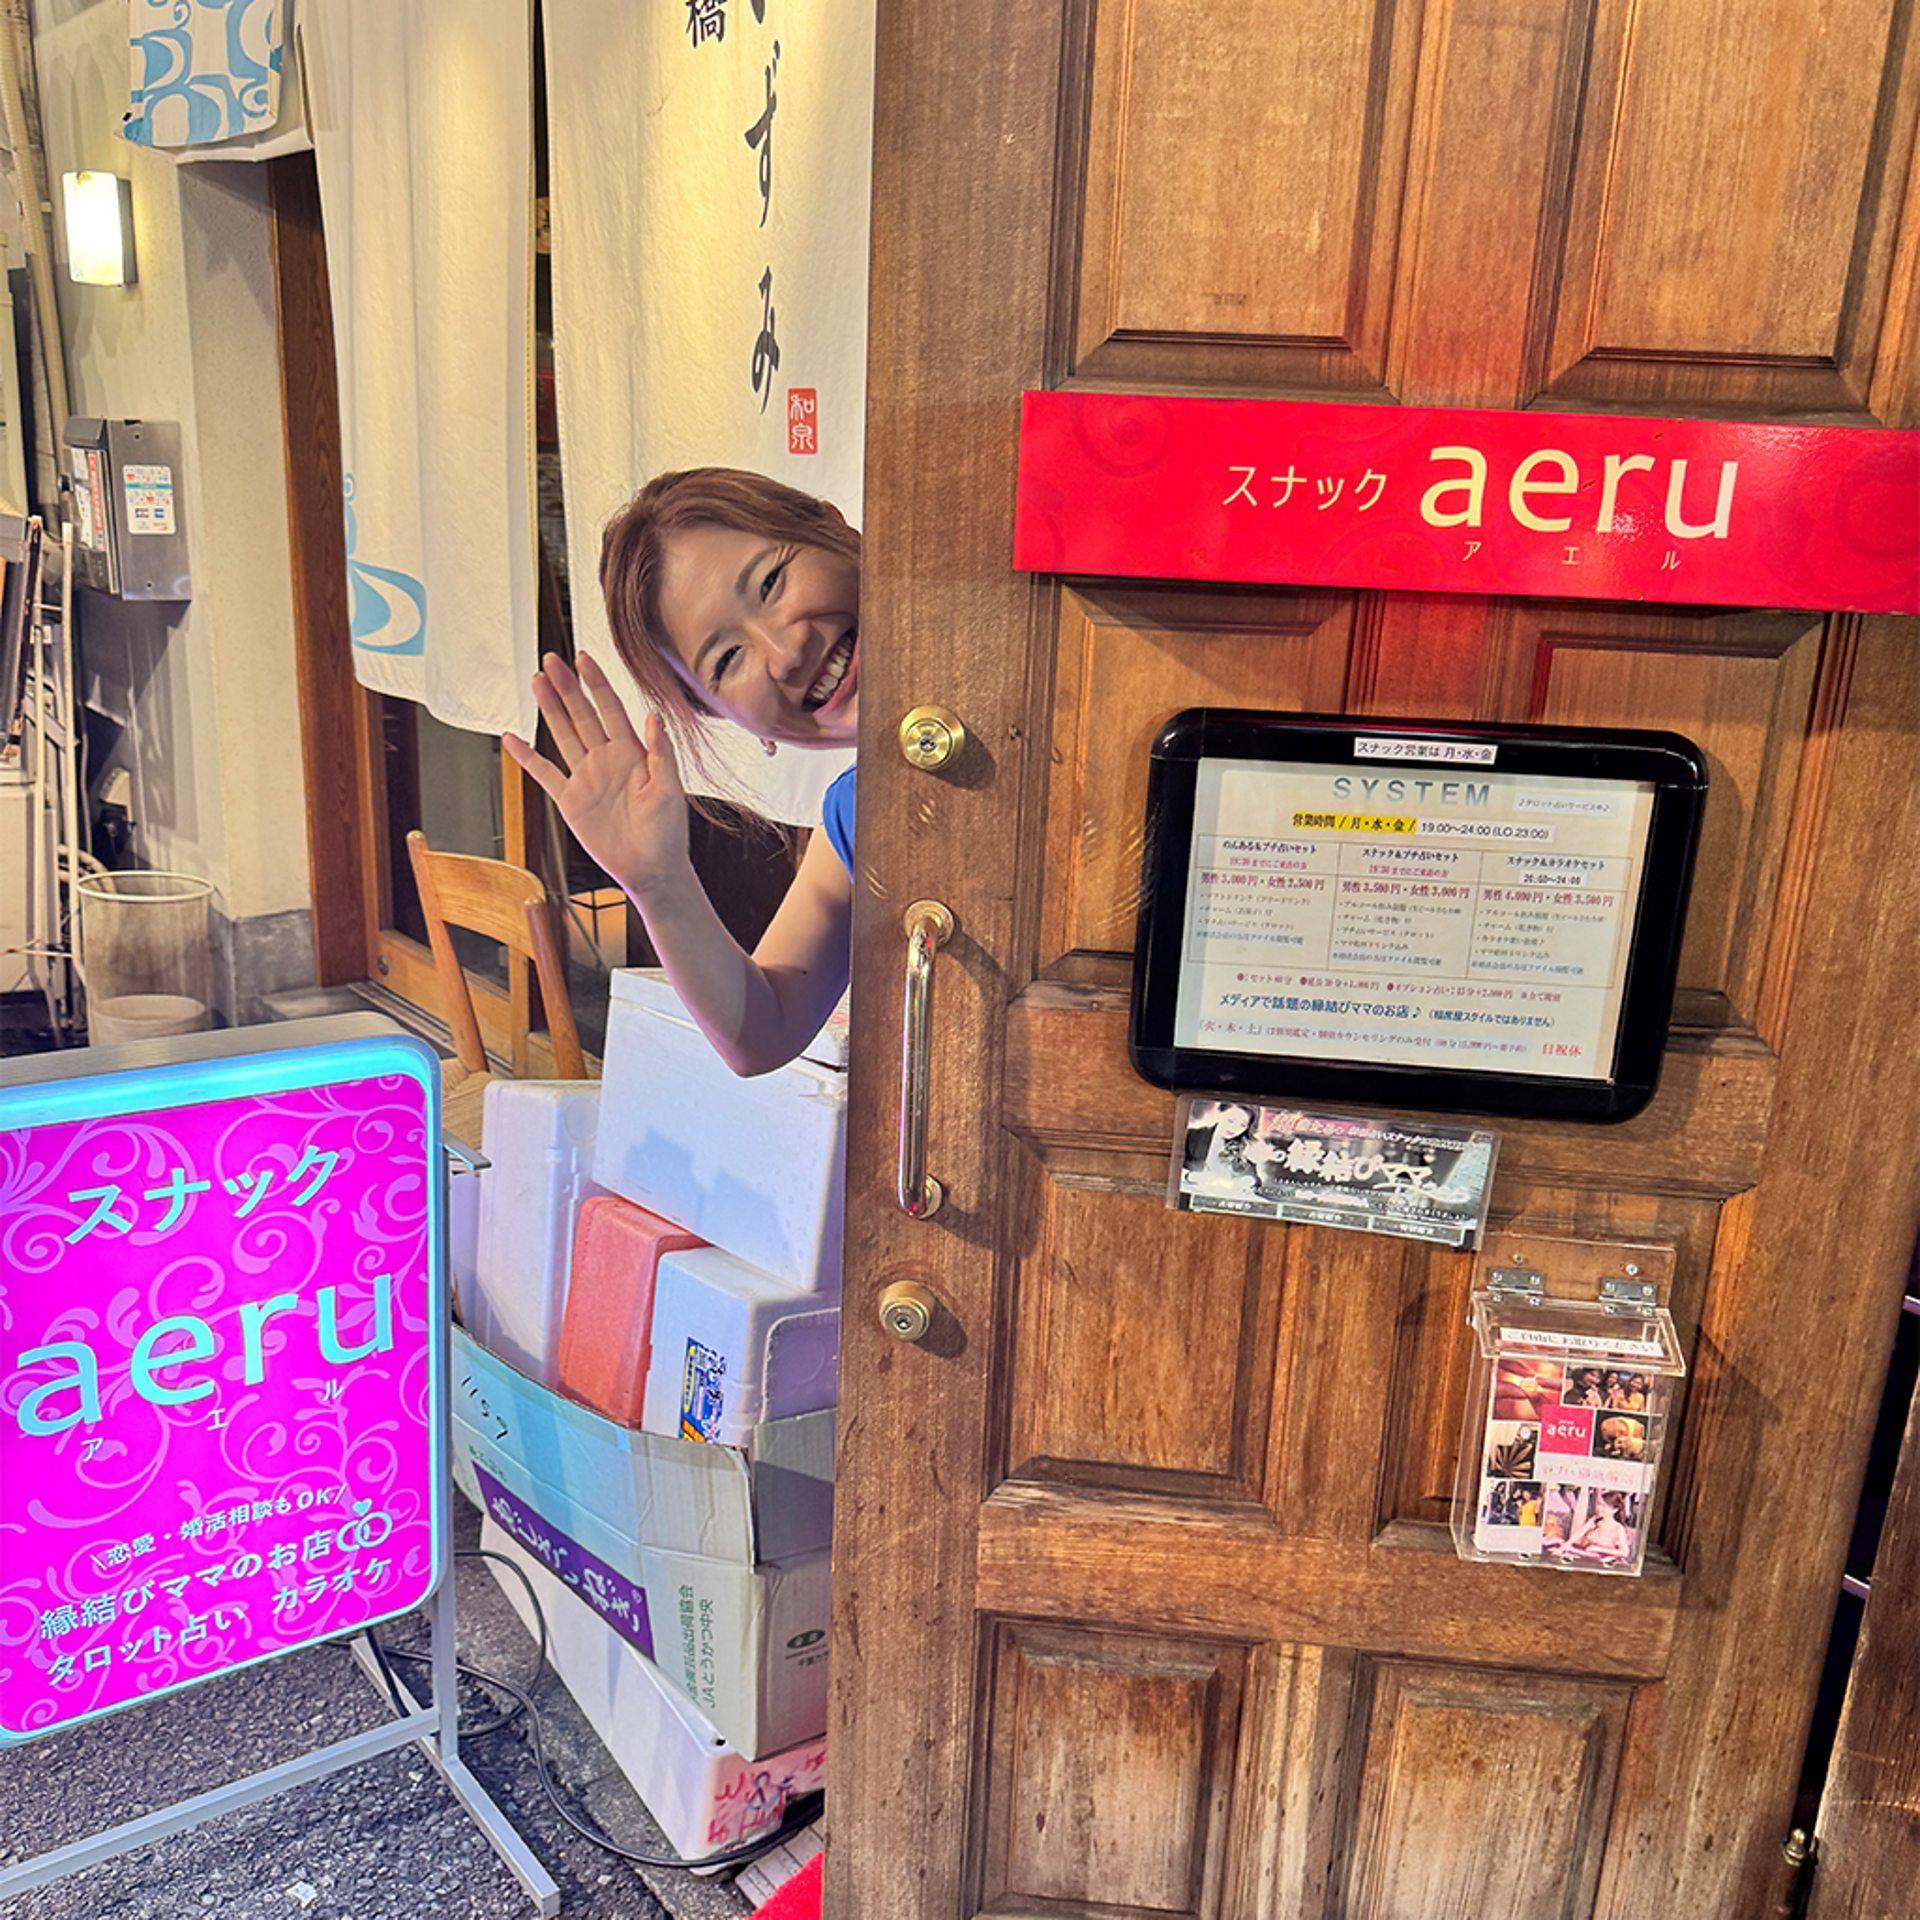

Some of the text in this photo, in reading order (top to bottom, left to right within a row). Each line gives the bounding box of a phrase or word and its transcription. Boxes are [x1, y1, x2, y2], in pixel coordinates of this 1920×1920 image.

[1220, 464, 1389, 515] スナック
[1418, 444, 1740, 540] aeru
[1332, 777, 1493, 808] SYSTEM
[64, 1143, 342, 1246] スナック
[16, 1273, 396, 1438] aeru
[1546, 1423, 1587, 1438] aeru
[39, 1529, 333, 1640] 縁結びママのお店
[46, 1556, 393, 1688] タロット占い カラオケ
